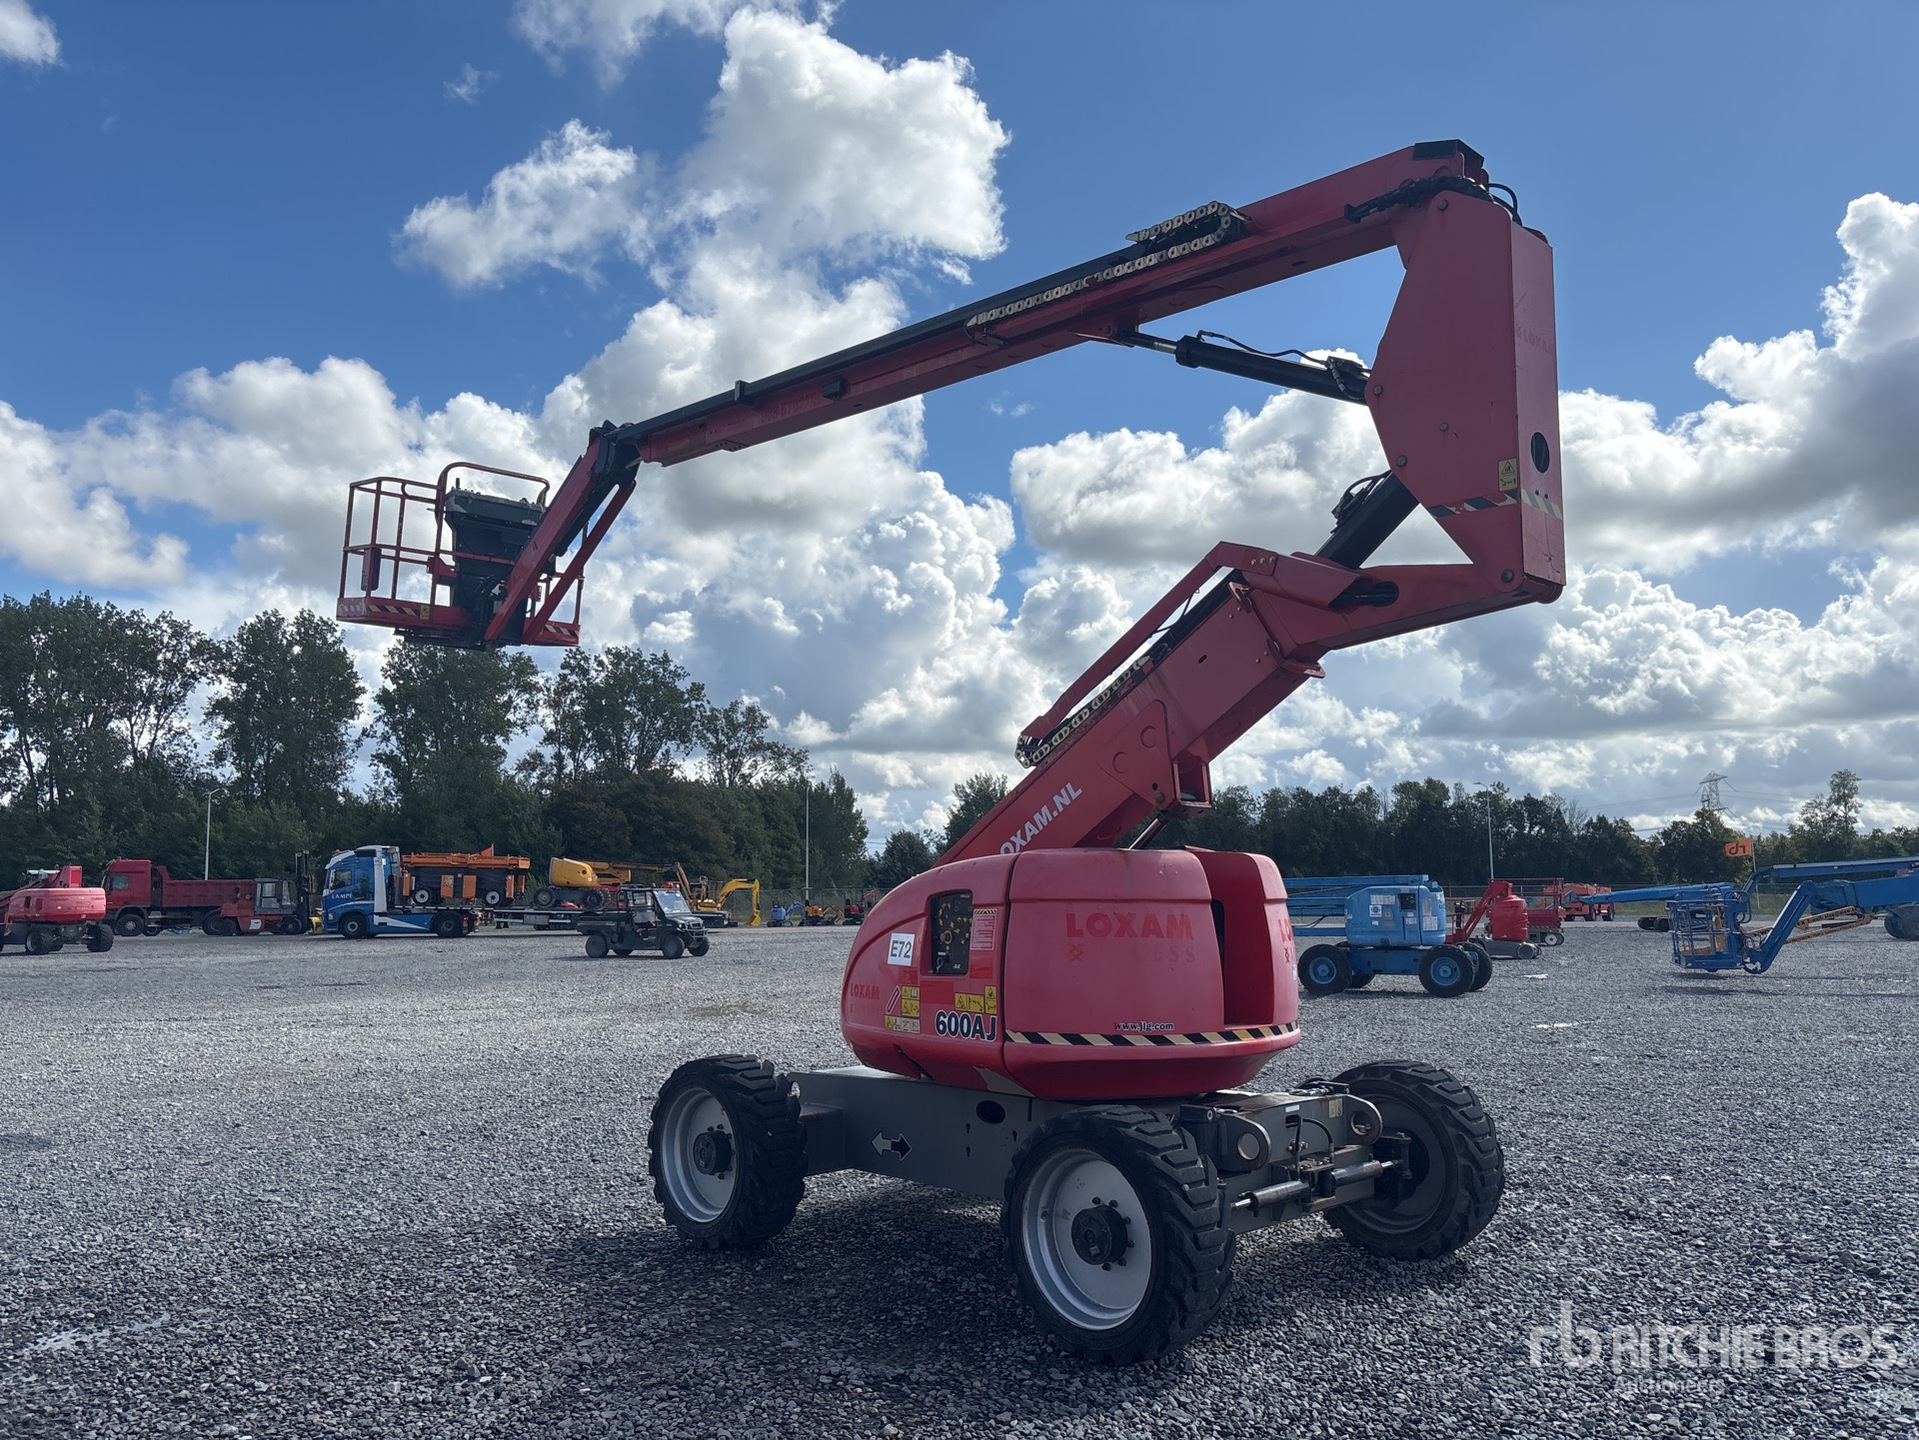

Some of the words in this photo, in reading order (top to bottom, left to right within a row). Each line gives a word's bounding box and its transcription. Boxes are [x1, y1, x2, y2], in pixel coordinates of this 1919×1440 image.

[1066, 912, 1194, 940] LOXAM
[890, 939, 912, 959] E72
[850, 983, 880, 1001] LOXAM
[935, 1010, 998, 1042] 600AJ
[1114, 1020, 1175, 1033] www.jlg.com
